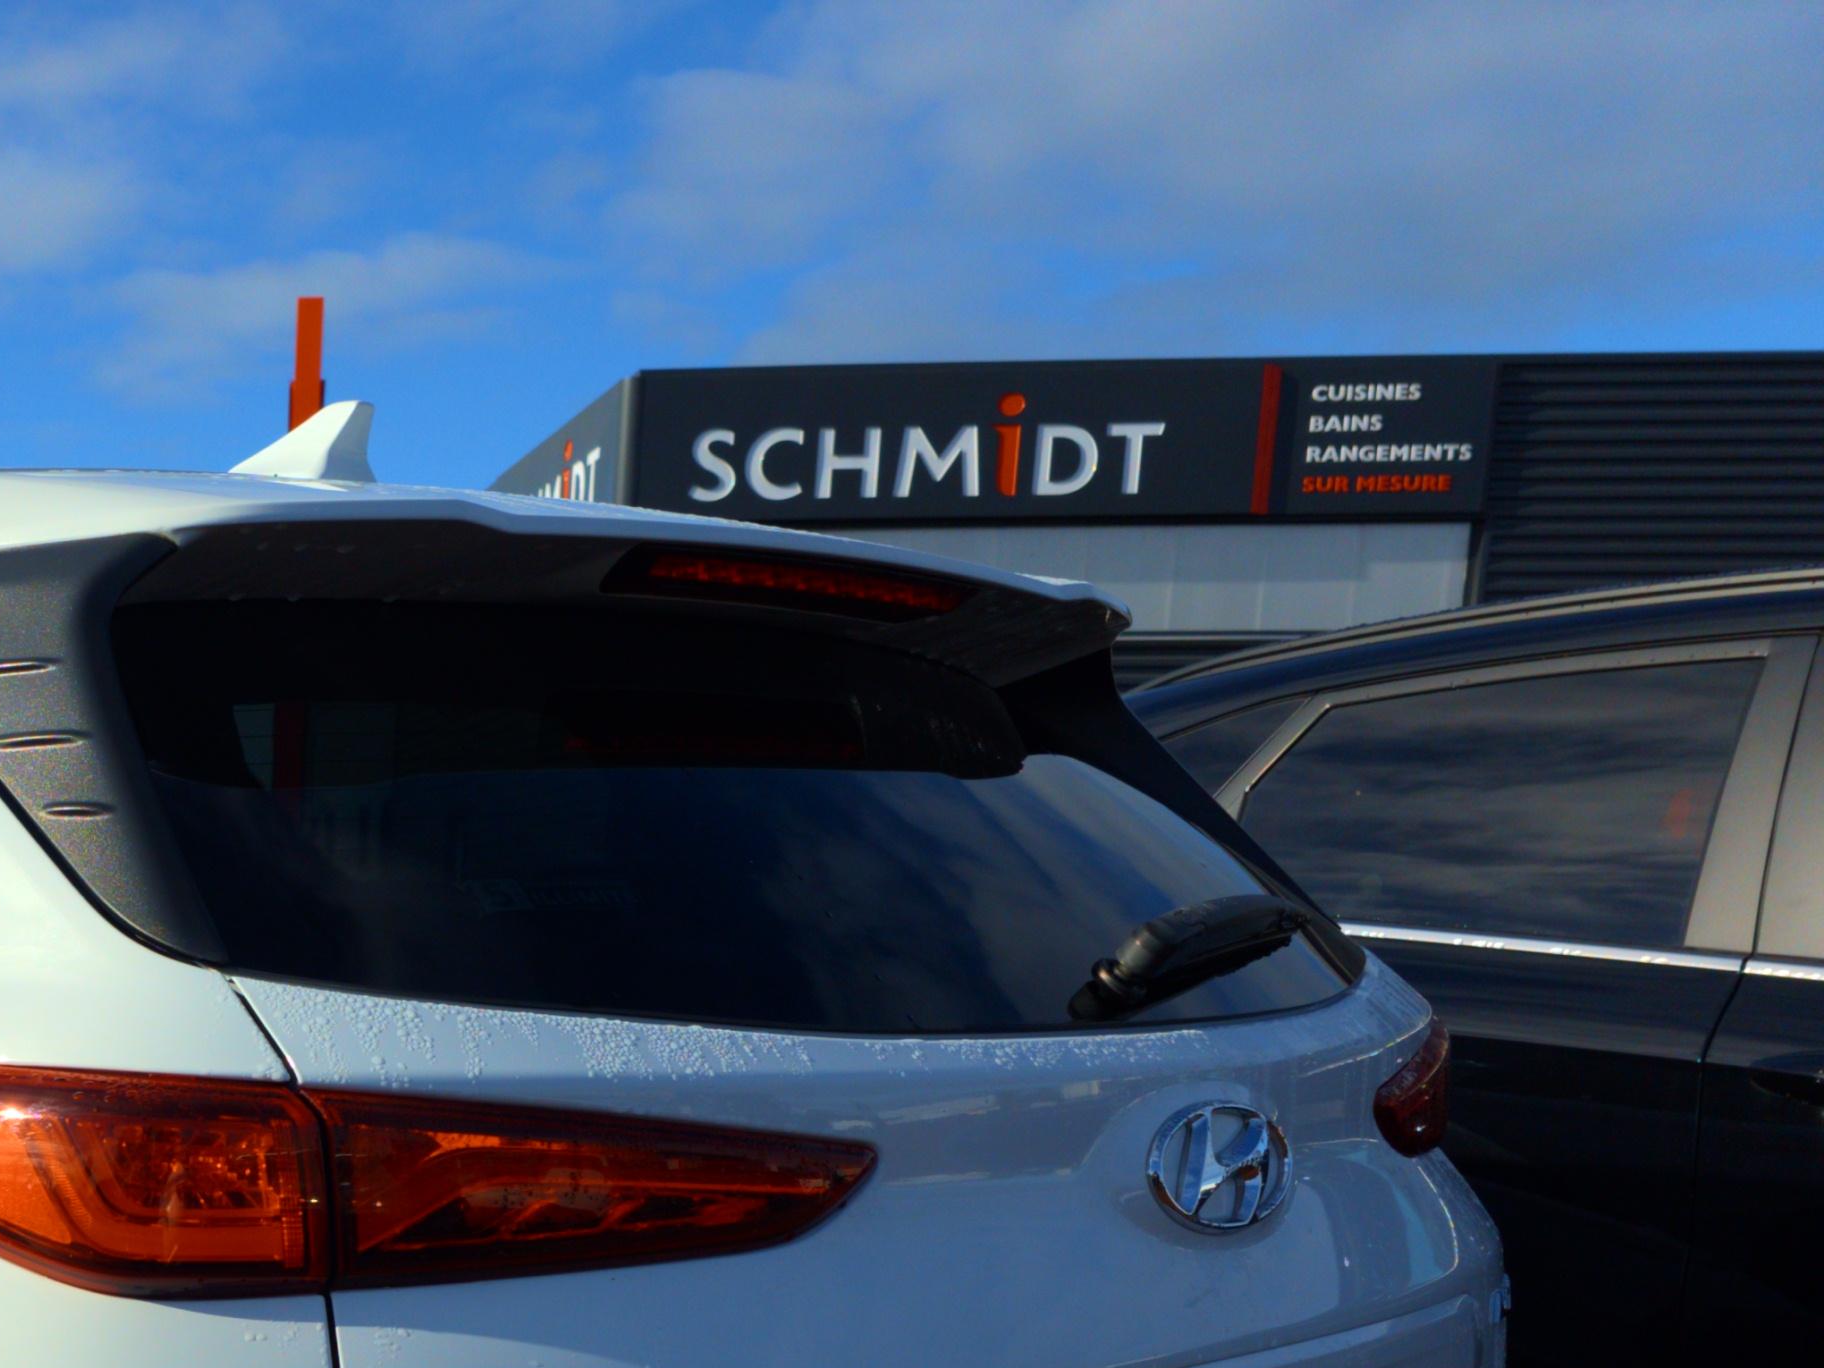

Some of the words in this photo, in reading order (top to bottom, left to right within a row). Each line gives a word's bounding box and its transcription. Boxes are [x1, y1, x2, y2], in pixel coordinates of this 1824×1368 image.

[1311, 382, 1422, 402] CUISINES
[1308, 413, 1384, 434] BAINS
[1305, 443, 1473, 463] RANGEMENTS
[1301, 474, 1349, 493] SUR
[1355, 473, 1452, 493] MESURE
